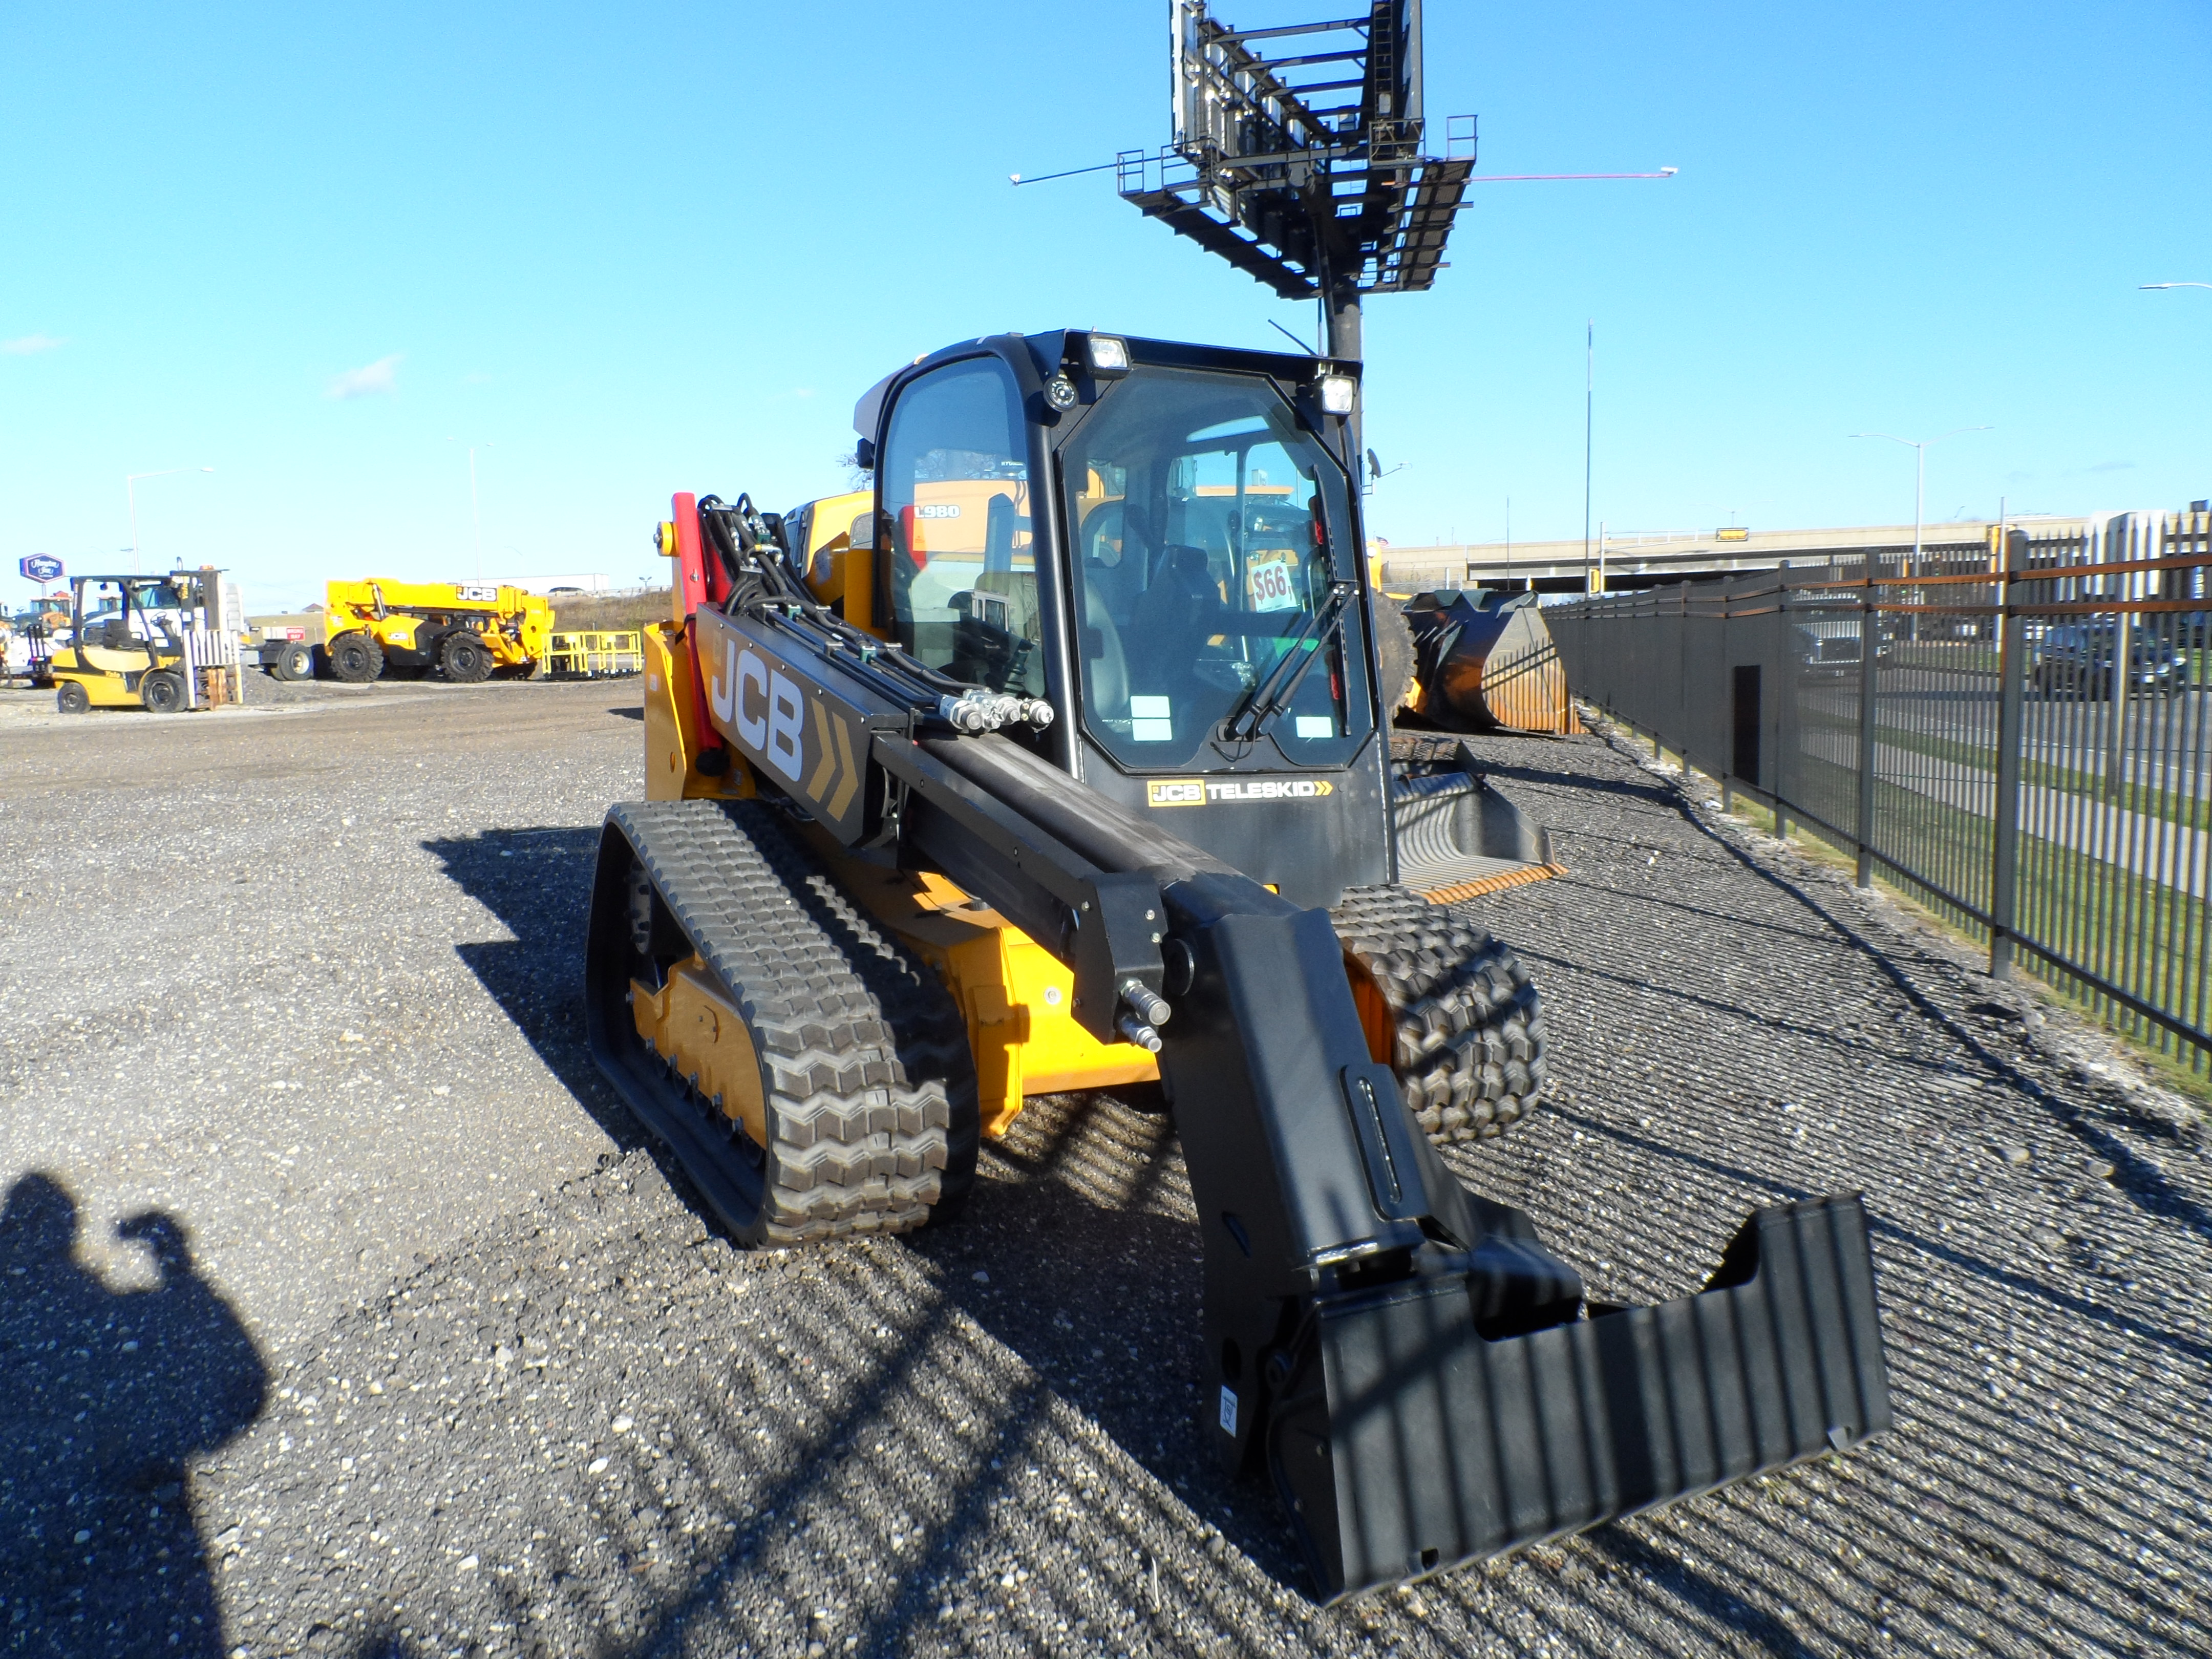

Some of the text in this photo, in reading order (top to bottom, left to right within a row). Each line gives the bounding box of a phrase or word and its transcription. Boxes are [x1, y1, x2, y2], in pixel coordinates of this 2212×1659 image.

[914, 505, 960, 519] L980
[456, 587, 497, 602] JCB
[712, 638, 804, 782] JCB
[1152, 781, 1315, 802] JCB TELESKID
